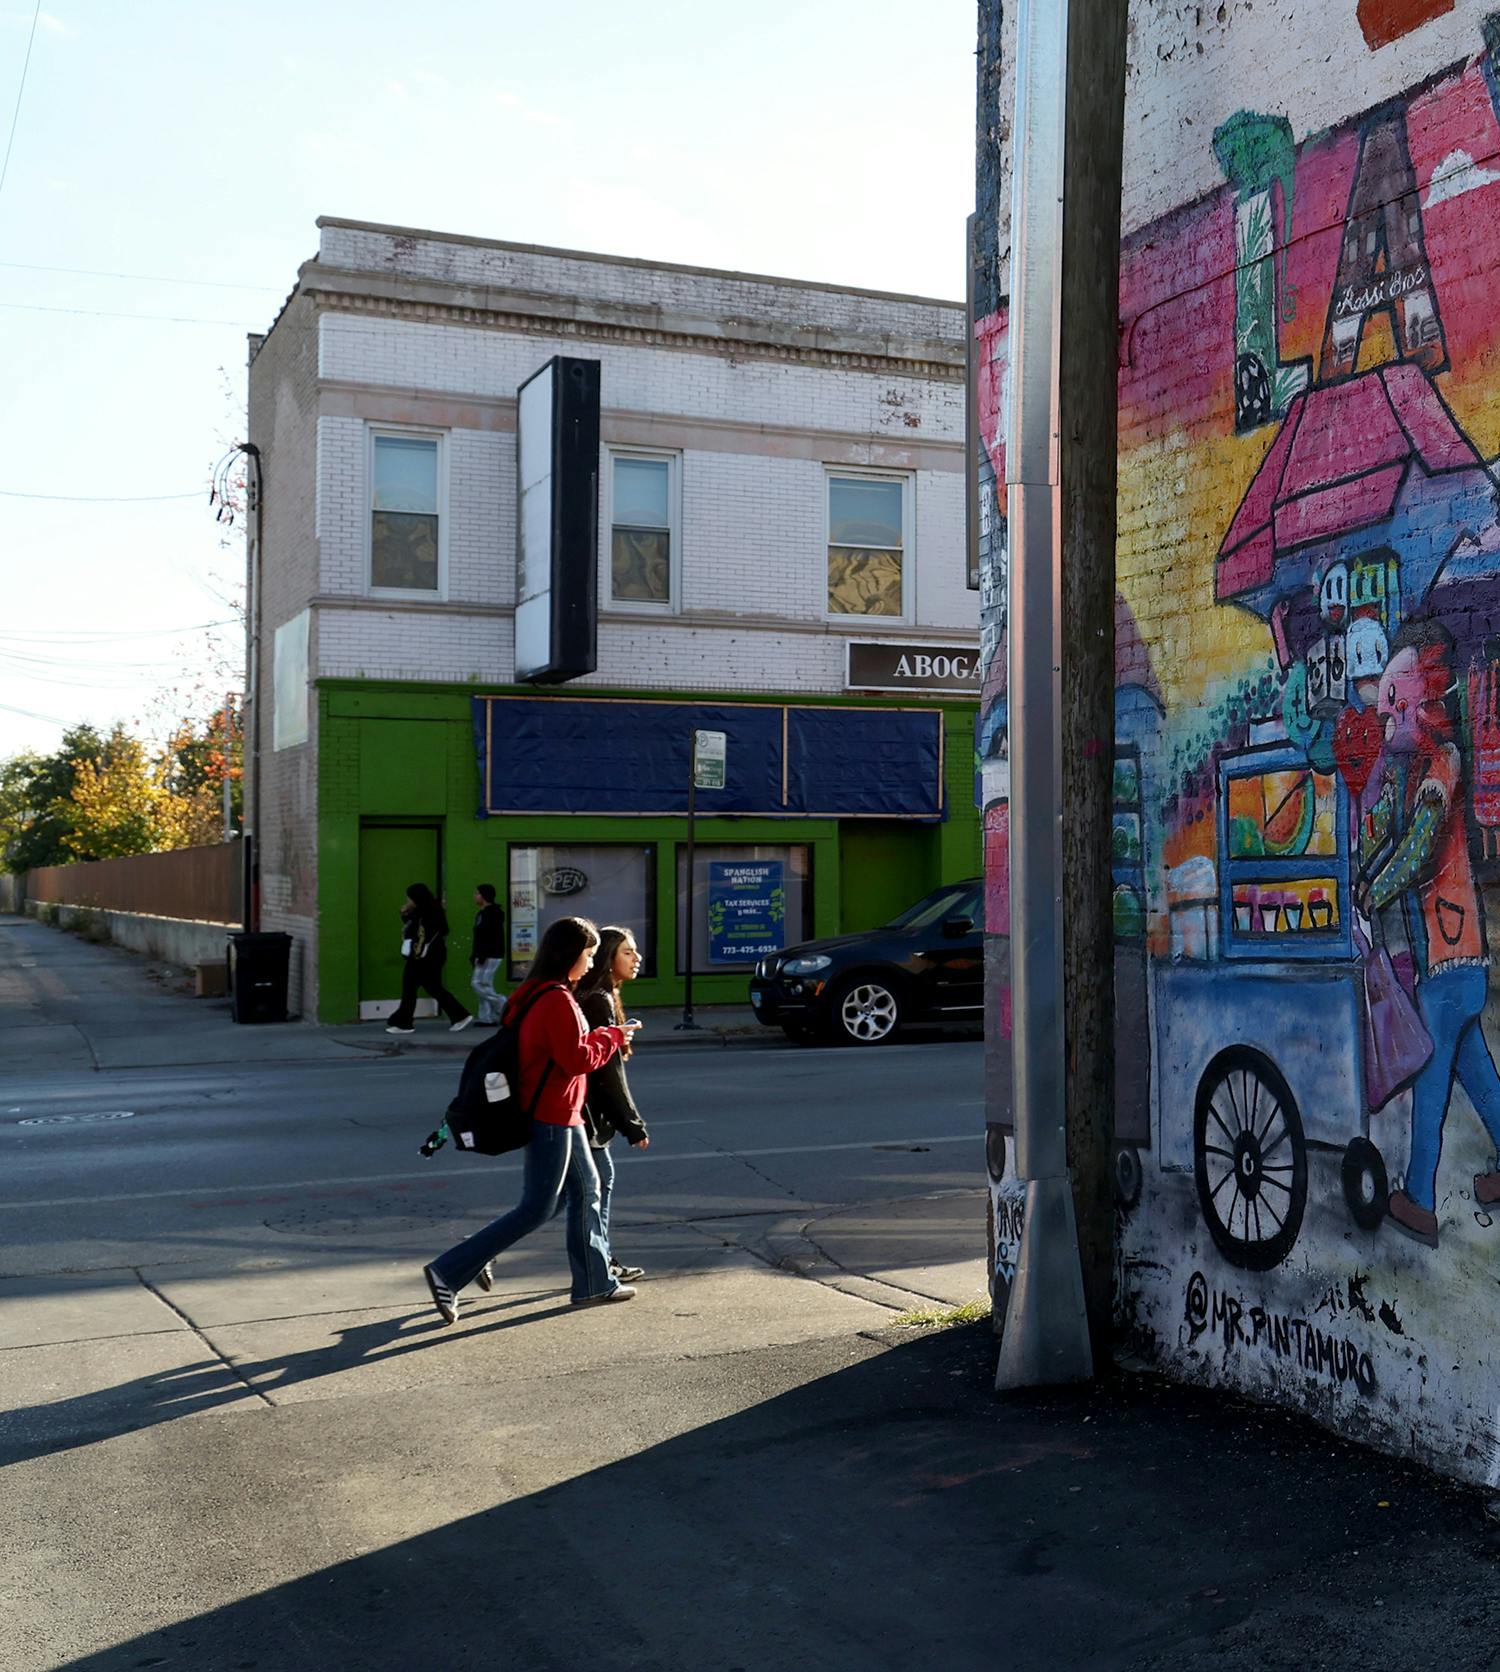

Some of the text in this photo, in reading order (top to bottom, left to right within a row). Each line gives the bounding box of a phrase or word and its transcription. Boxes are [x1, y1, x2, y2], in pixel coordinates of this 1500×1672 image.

[723, 868, 769, 877] SPANGLISH
[731, 876, 762, 884] NATION
[724, 899, 769, 907] TAX SERVICES
